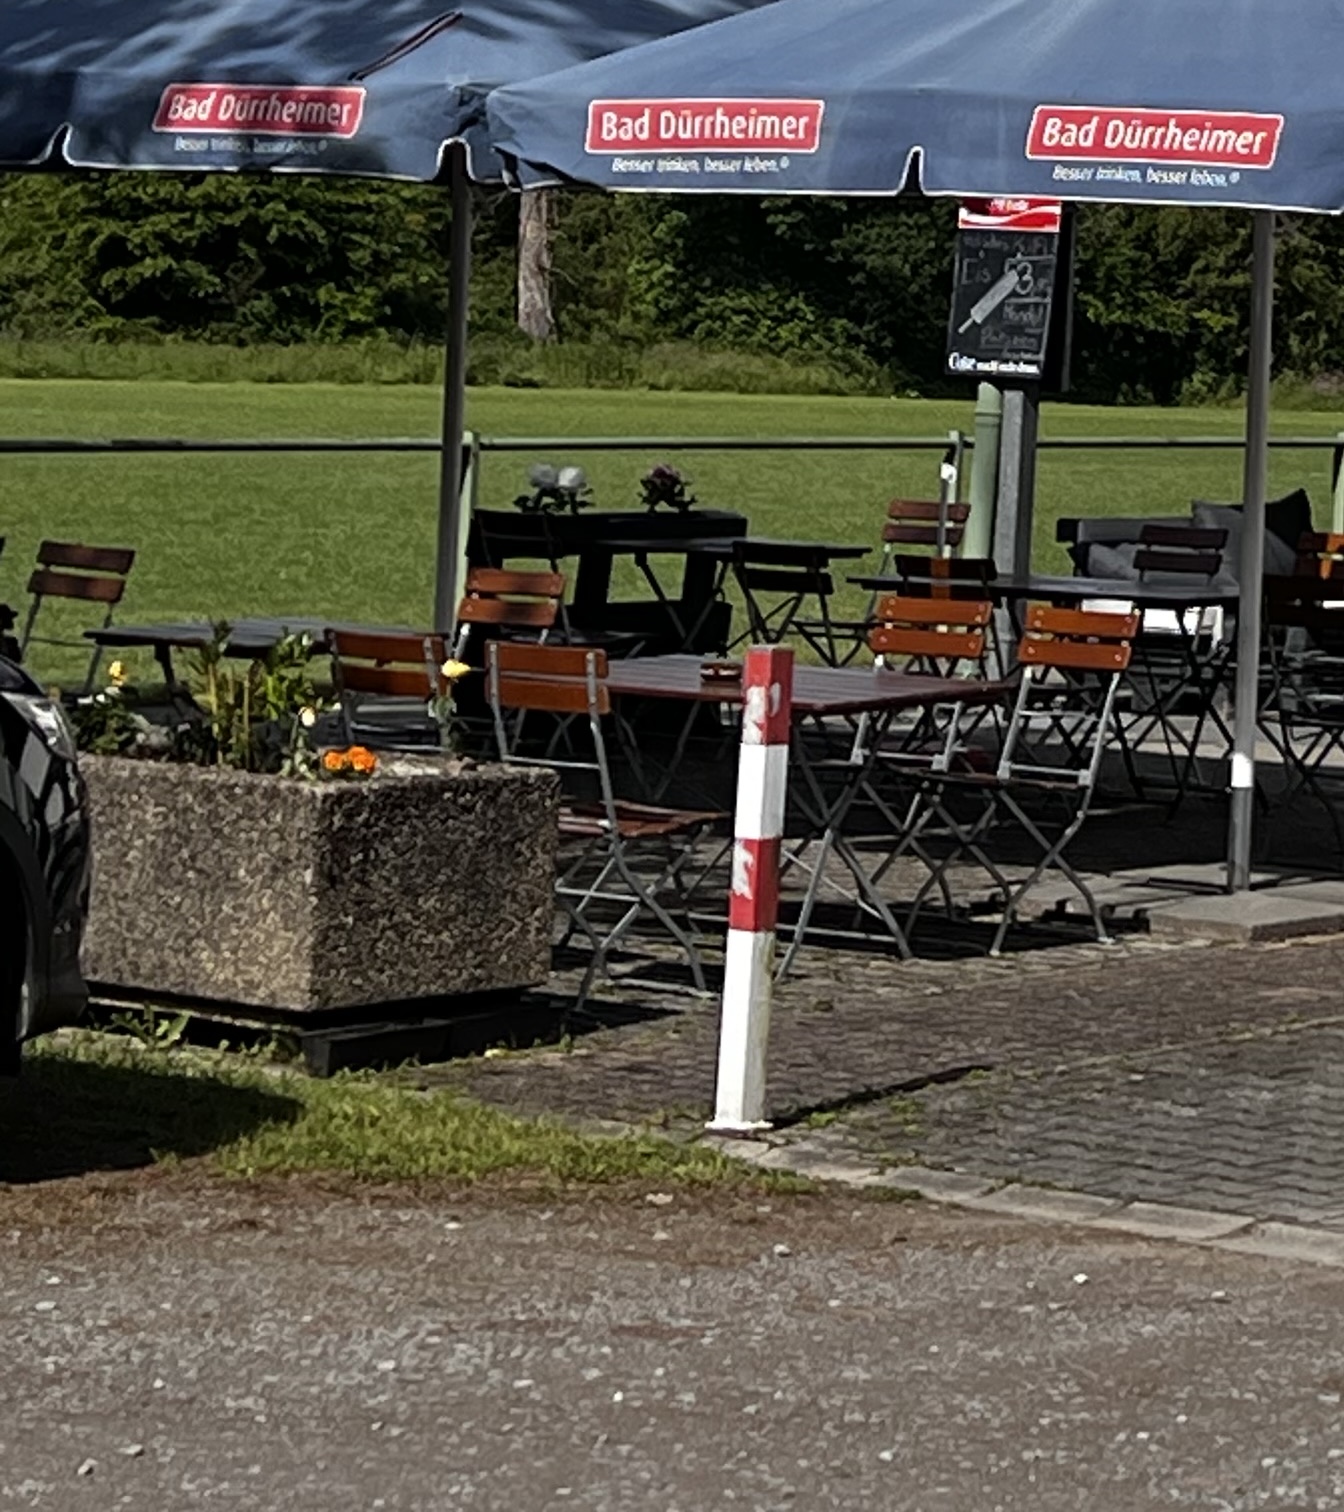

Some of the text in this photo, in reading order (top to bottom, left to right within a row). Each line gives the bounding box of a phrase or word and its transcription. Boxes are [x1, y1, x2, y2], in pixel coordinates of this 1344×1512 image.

[167, 90, 351, 127] Bad Dürrheimer
[601, 107, 809, 141] Bad Dürrheimer
[1042, 115, 1267, 155] Bad Dürrheimer
